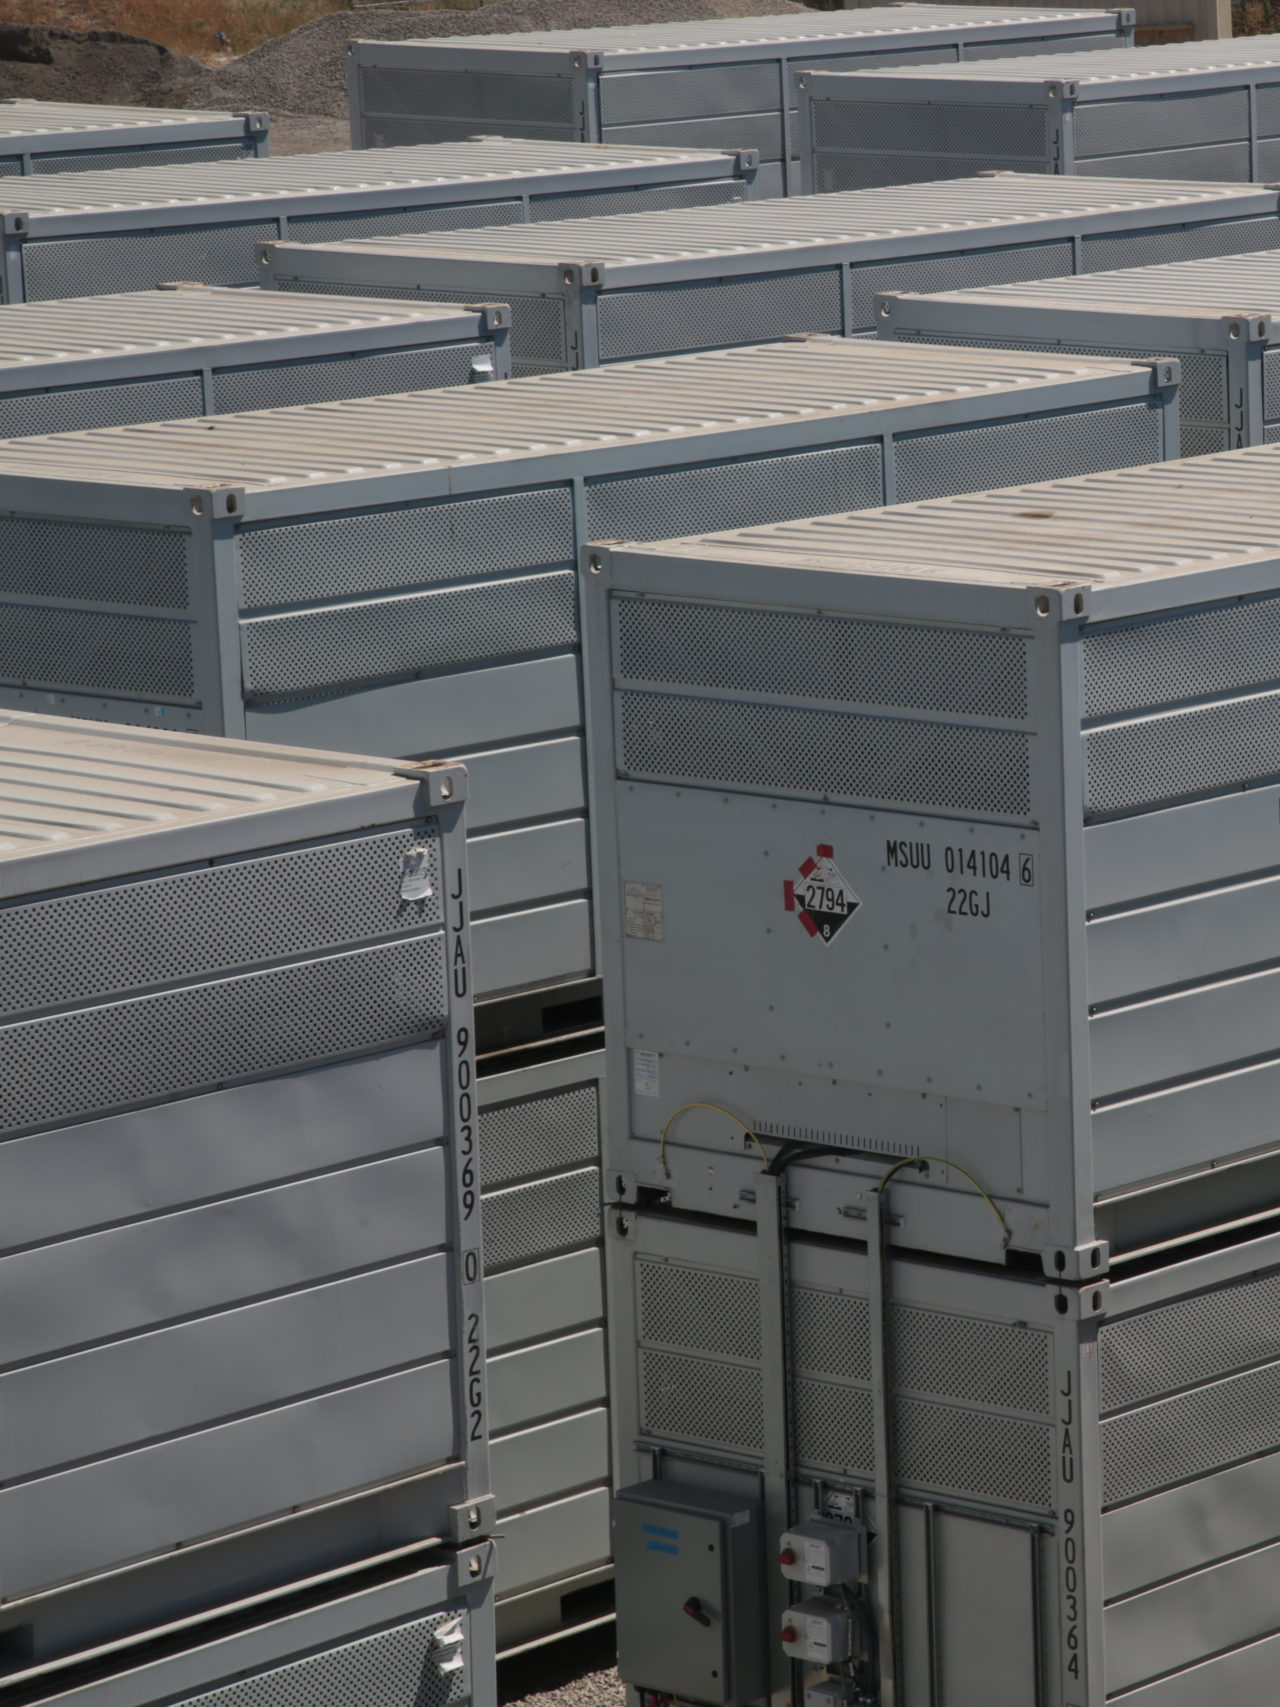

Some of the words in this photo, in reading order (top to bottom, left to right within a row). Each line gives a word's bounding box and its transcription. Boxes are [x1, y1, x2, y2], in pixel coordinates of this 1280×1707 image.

[806, 885, 846, 912] 2794
[886, 839, 931, 870] MSUU
[944, 846, 1011, 881] 014104
[1021, 855, 1032, 885] 6
[451, 868, 467, 998] JJAU
[823, 924, 830, 937] 8
[946, 887, 990, 918] 22GJ
[456, 1027, 475, 1221] 900369
[1061, 1370, 1074, 1483] JJAU
[1063, 1508, 1079, 1680] 900364
